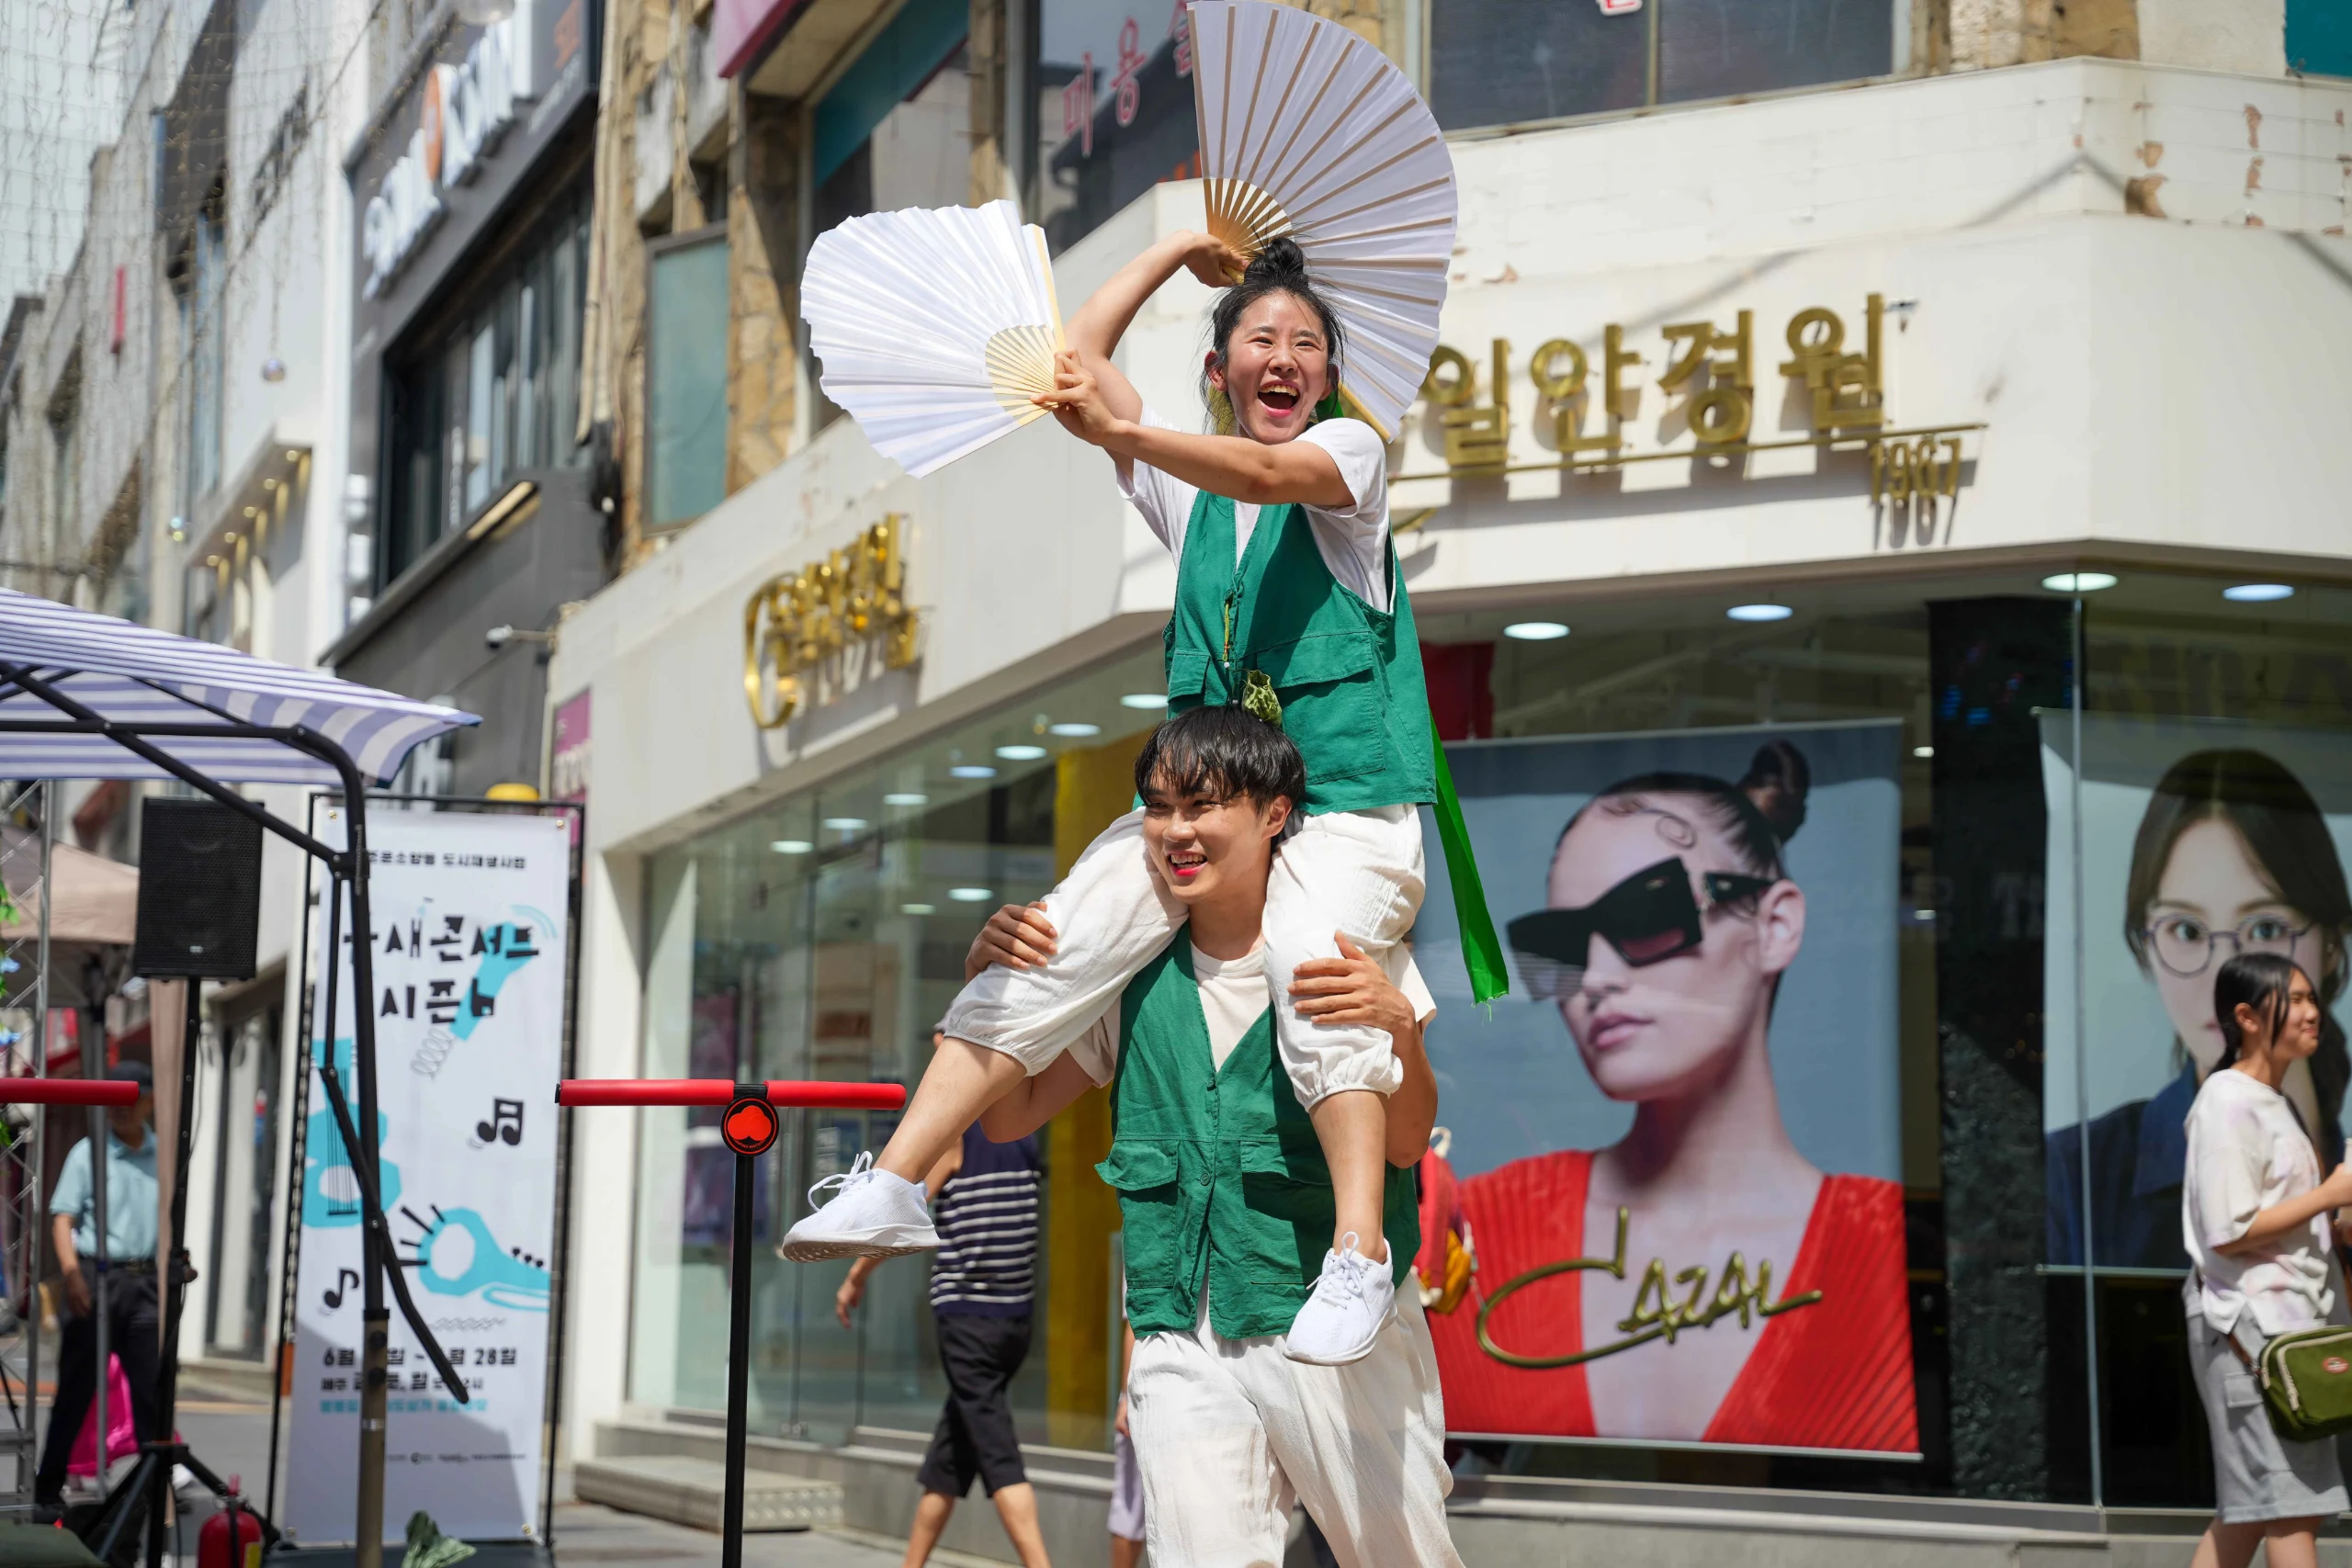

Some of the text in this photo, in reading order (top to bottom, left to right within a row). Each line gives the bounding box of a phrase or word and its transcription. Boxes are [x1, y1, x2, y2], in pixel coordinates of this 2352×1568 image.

[1419, 292, 1885, 467] 일안경원
[1869, 436, 1962, 503] 1967
[323, 1348, 355, 1366] 6월
[474, 1348, 517, 1366] 28일
